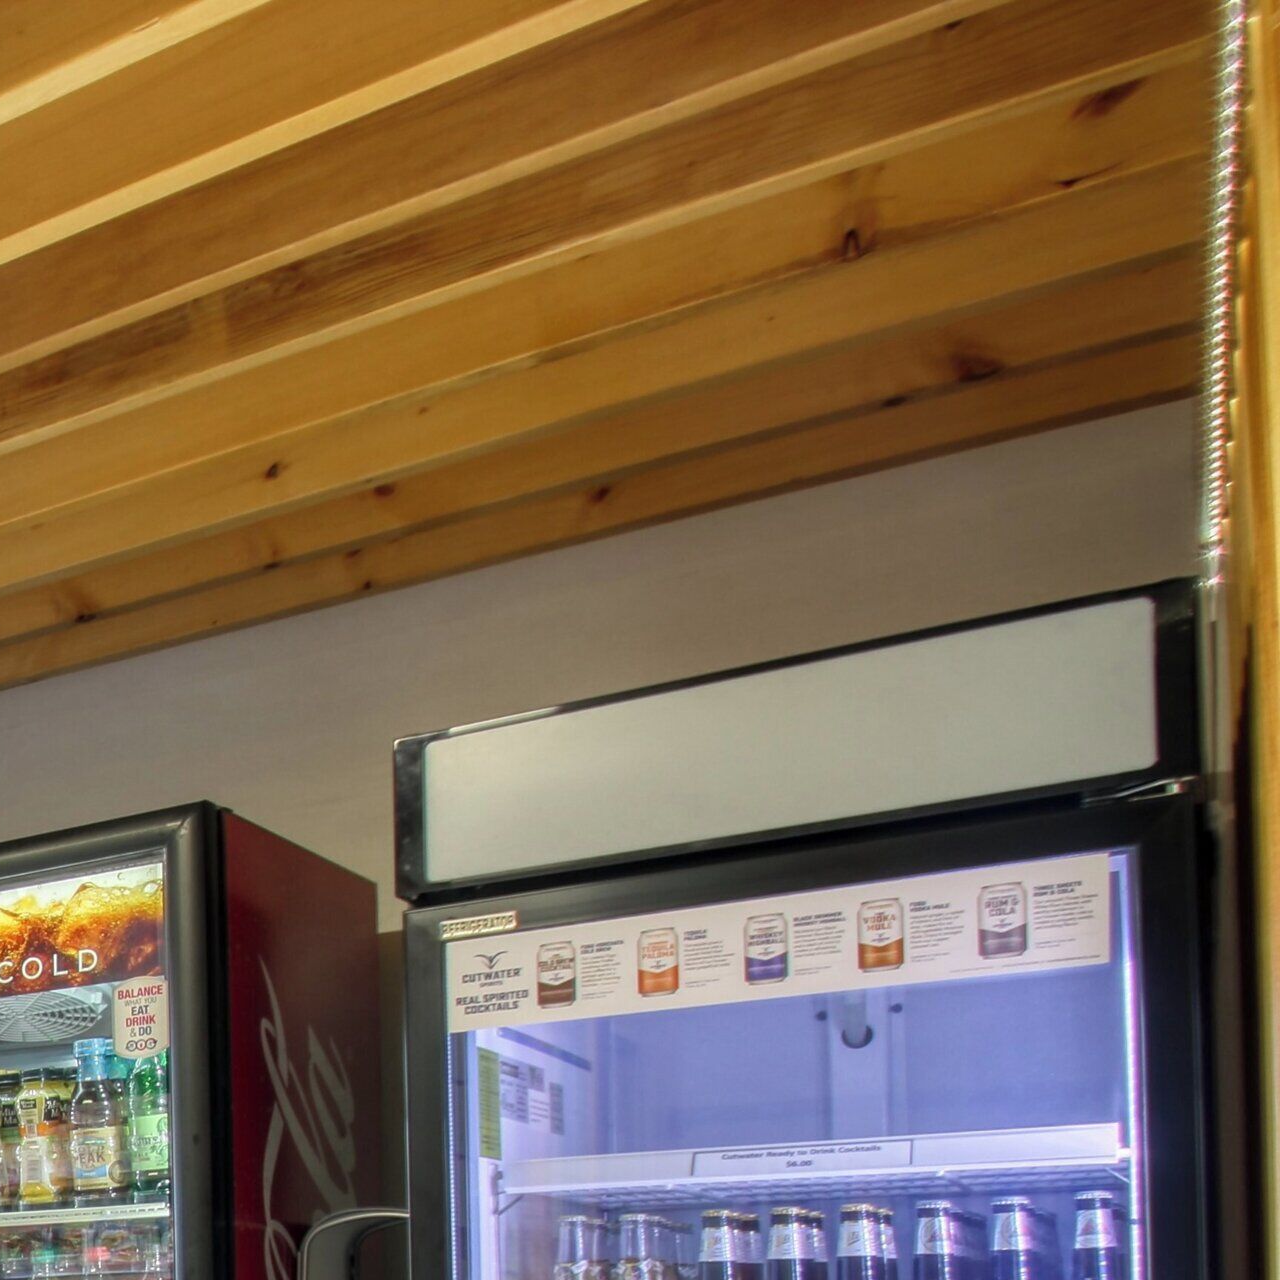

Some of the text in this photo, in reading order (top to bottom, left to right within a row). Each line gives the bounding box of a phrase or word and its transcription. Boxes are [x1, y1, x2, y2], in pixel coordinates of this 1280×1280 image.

[462, 967, 522, 984] CUTWATER
[117, 984, 164, 1001] BALANCE
[456, 989, 529, 1007] REAL SPIRITED
[130, 1004, 150, 1016] EAT
[464, 1001, 520, 1015] COCKTAILS
[125, 1014, 156, 1027] DRINK
[138, 1026, 152, 1037] DO
[721, 1151, 764, 1161] Cutwater
[766, 1149, 795, 1159] Ready
[810, 1147, 836, 1155] Drink
[838, 1144, 882, 1154] Cocktails
[786, 1159, 813, 1168] $6.00
